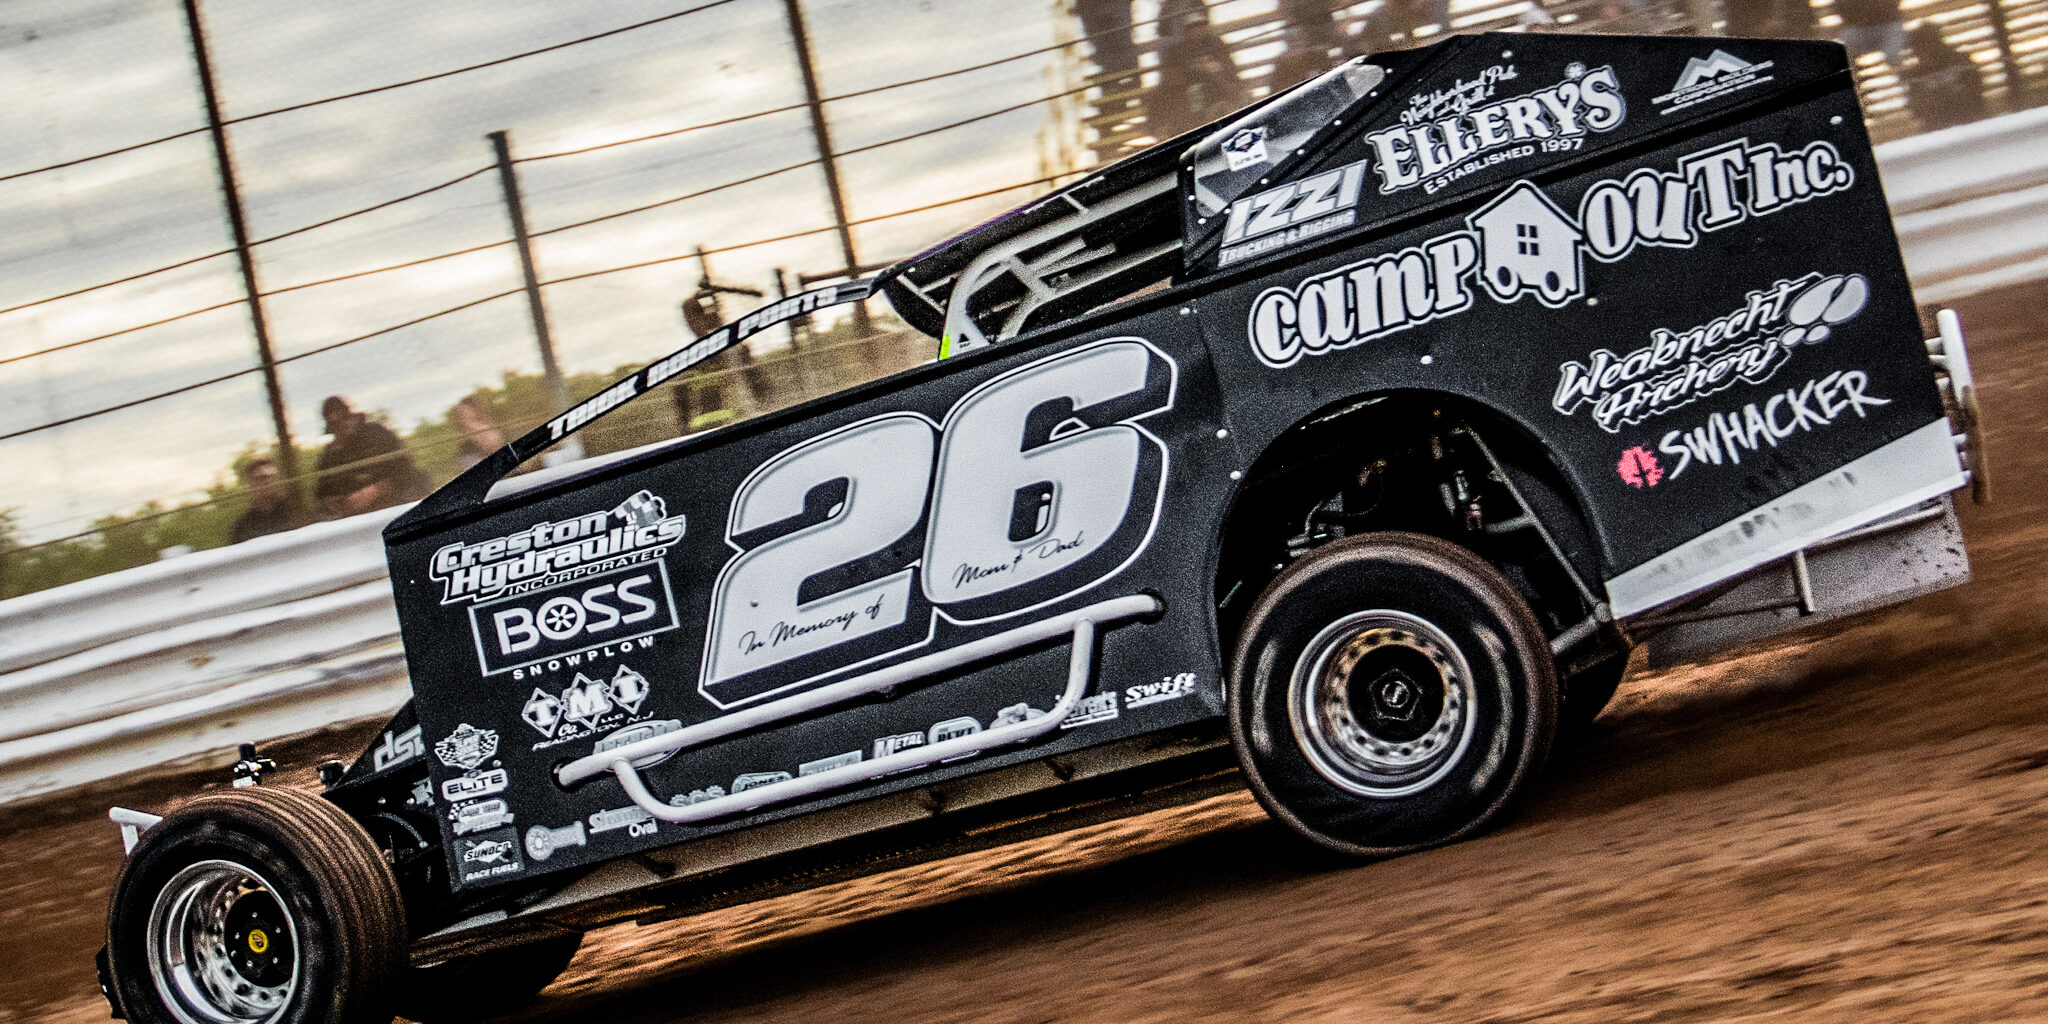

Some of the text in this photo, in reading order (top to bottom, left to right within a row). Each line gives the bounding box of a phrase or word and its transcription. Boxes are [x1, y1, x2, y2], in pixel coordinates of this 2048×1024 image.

[1370, 67, 1625, 194] ELLERY'S
[1424, 137, 1584, 195] ESTABLISHED 1997
[1221, 160, 1368, 248] IZZI
[1217, 209, 1356, 267] TRUCKING & RIGGING
[1559, 281, 1808, 405] Weaknecht
[1597, 341, 1780, 422] Archery
[1659, 370, 1892, 480] SWHACKER
[435, 512, 608, 574] Creston
[702, 339, 1162, 697] 26
[449, 517, 684, 597] Hydraulics
[509, 548, 668, 594] INCORPORATED
[953, 560, 1009, 589] Mom
[1030, 530, 1087, 560] Dad
[493, 574, 657, 655] BOSS
[738, 594, 885, 656] In Memory of
[513, 636, 655, 680] SNOWPLOW
[1125, 672, 1196, 702] Swift
[601, 713, 624, 724] LLC
[629, 818, 658, 839] Oval
[465, 862, 519, 881] RACE FUELS
